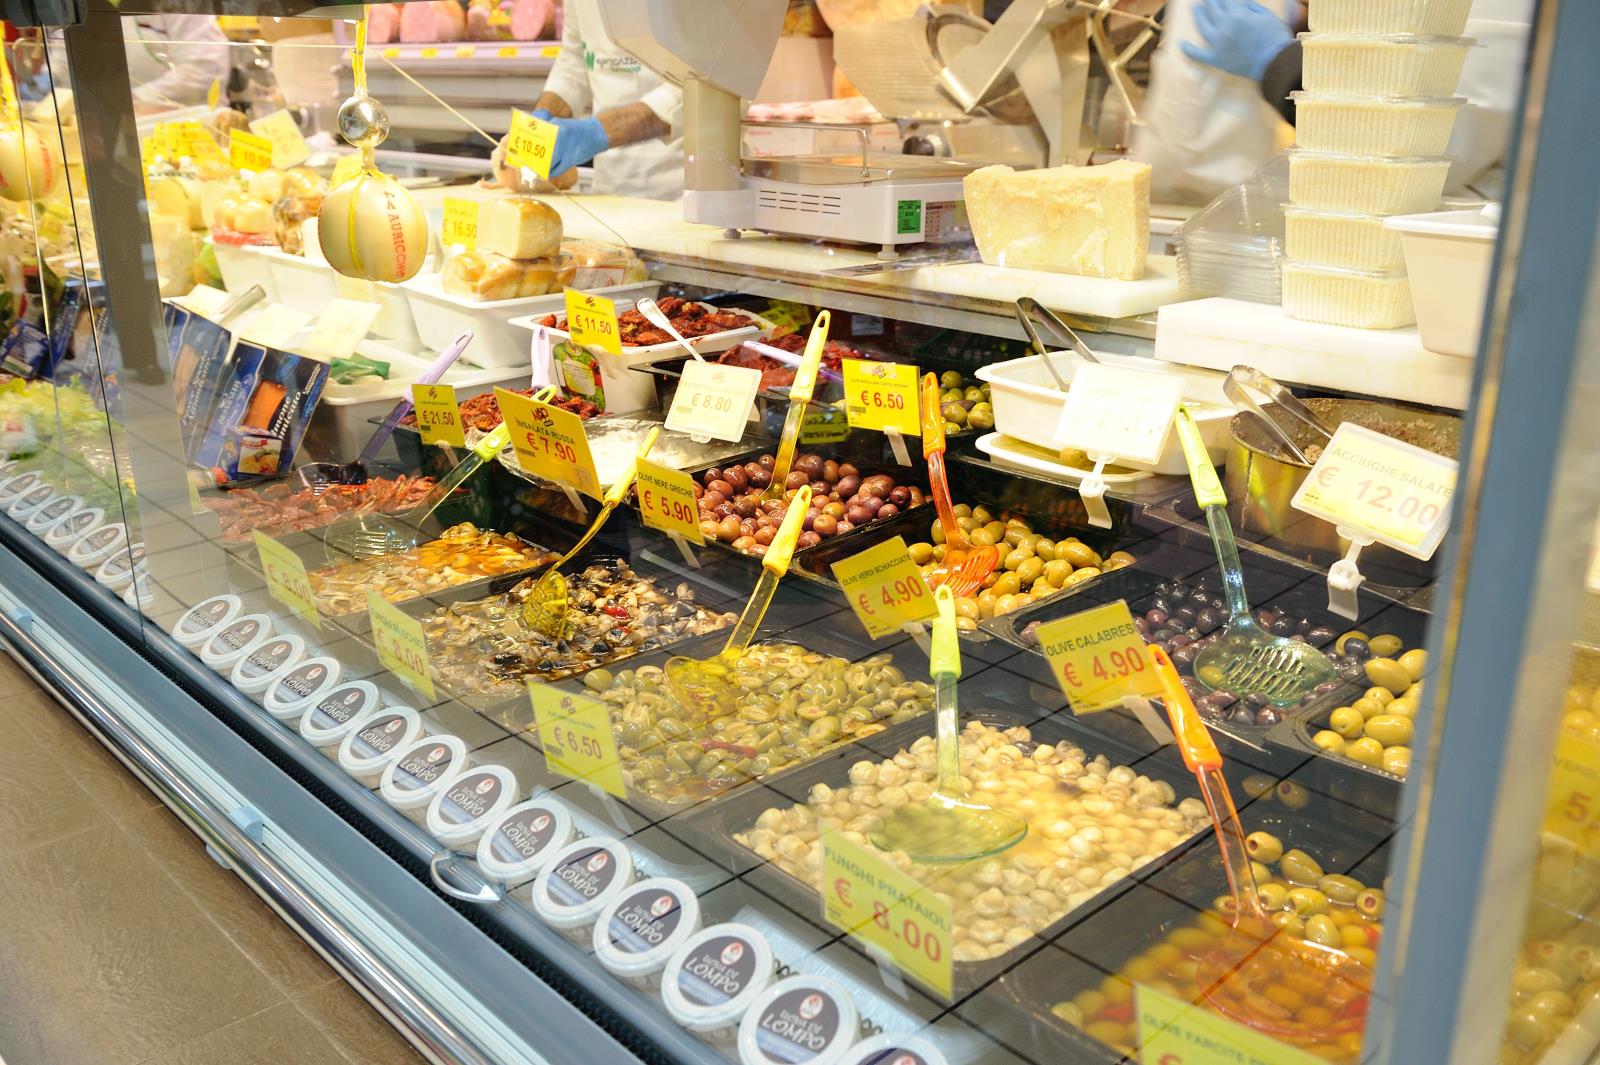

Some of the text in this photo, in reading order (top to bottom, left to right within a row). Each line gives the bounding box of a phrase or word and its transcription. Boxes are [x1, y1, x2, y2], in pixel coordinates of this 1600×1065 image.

[522, 140, 546, 159] 10.50
[453, 220, 478, 240] 16.50
[575, 314, 612, 336] € 11.50
[692, 393, 732, 412] € 8.80
[860, 390, 904, 410] € 6.50
[422, 410, 455, 426] € 21.50
[526, 432, 577, 464] € 7.90
[638, 471, 694, 499] OLIVE NERE GRECHE
[1331, 447, 1455, 498] ACCIUGHE SALATE
[643, 490, 693, 525] € 5.90
[1316, 465, 1341, 488] €
[1356, 479, 1440, 526] 12.00
[842, 553, 912, 586] OLIVE VERDI SCHIACCIATE
[859, 575, 924, 615] € 4.90
[1046, 623, 1135, 657] OLIVE CALABRES
[392, 639, 425, 676] 8.00
[1063, 646, 1145, 688] € 4.90
[282, 676, 312, 697] LOMPO
[319, 701, 350, 723] LOMPO
[359, 728, 391, 751] LOMPO
[554, 726, 602, 760] € 6.50
[400, 758, 437, 781] LOMPO
[448, 787, 485, 816] LOMPO
[502, 821, 536, 857] LOMPO
[556, 863, 598, 897] LOMPO
[824, 847, 875, 887] FUNGHI
[617, 905, 663, 944] LOMPO
[834, 878, 942, 964] € 8.00
[684, 956, 740, 994] LOMPO
[762, 1012, 826, 1050] LOMPO
[1143, 1013, 1181, 1038] OLIVE
[1184, 1031, 1245, 1063] FARCITE
